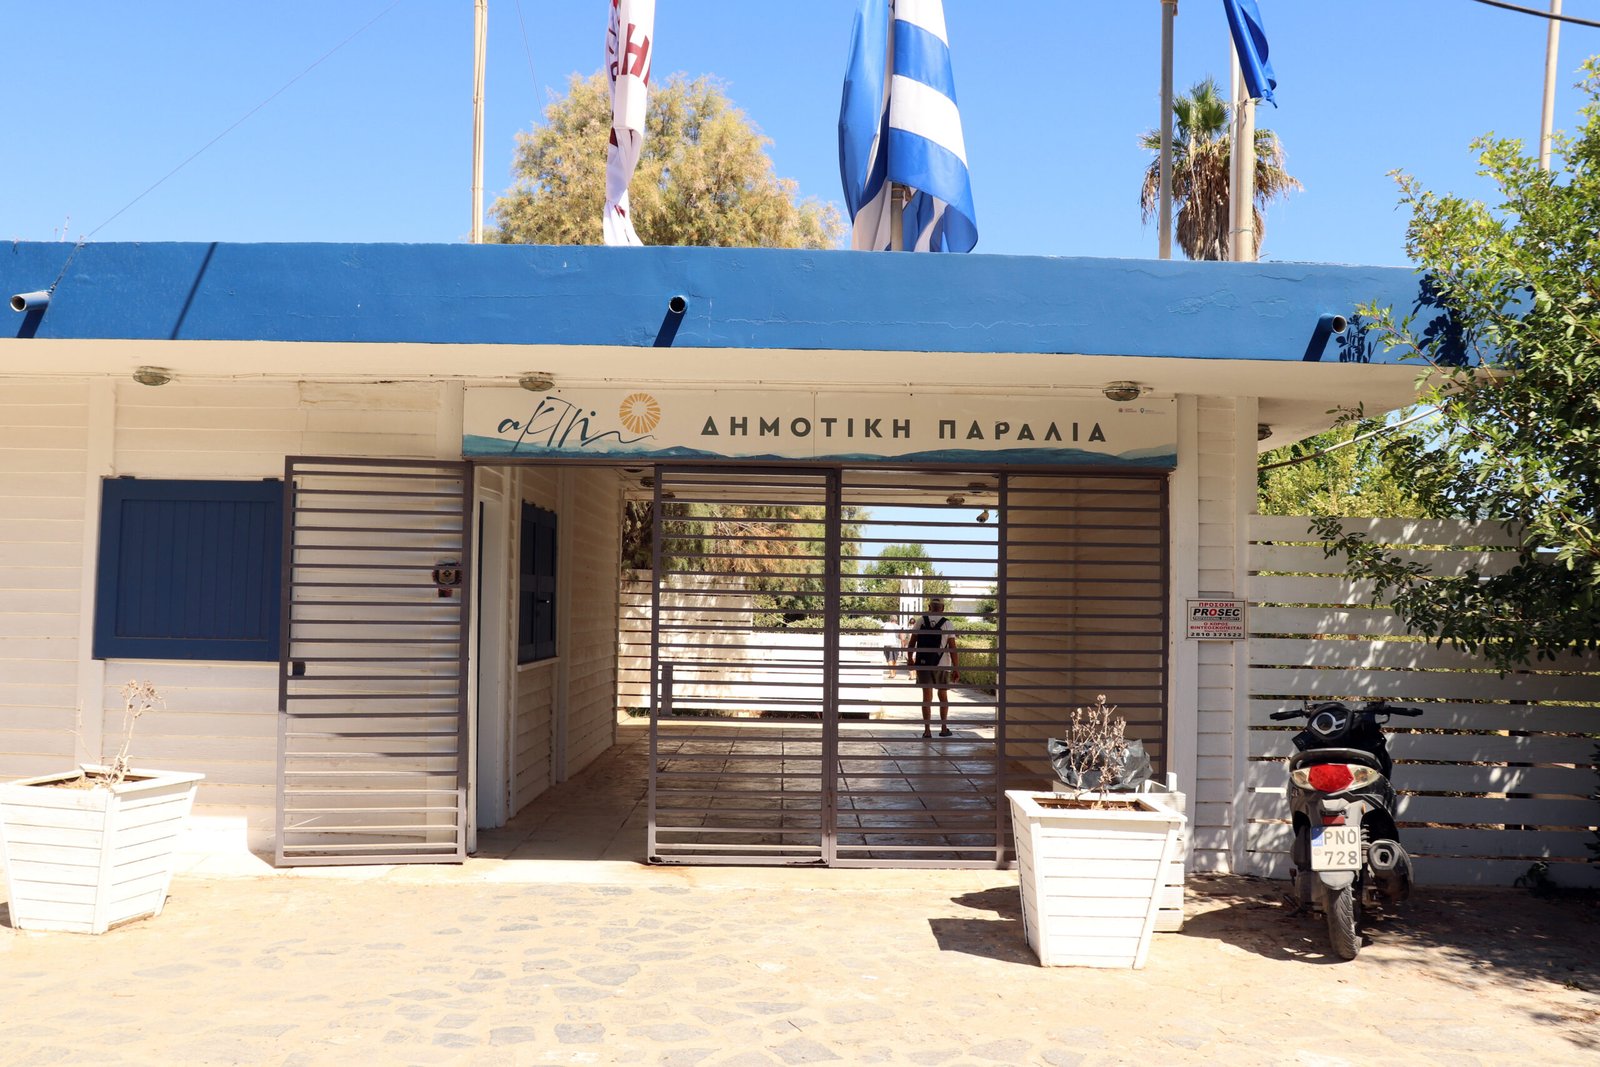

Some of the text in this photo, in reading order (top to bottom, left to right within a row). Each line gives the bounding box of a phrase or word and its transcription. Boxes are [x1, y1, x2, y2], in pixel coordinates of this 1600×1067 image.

[700, 415, 1107, 443] ΔΗΜΟΤΙΚΗ ΠΑΡΑΛΙΑ
[1324, 850, 1358, 866] 728
